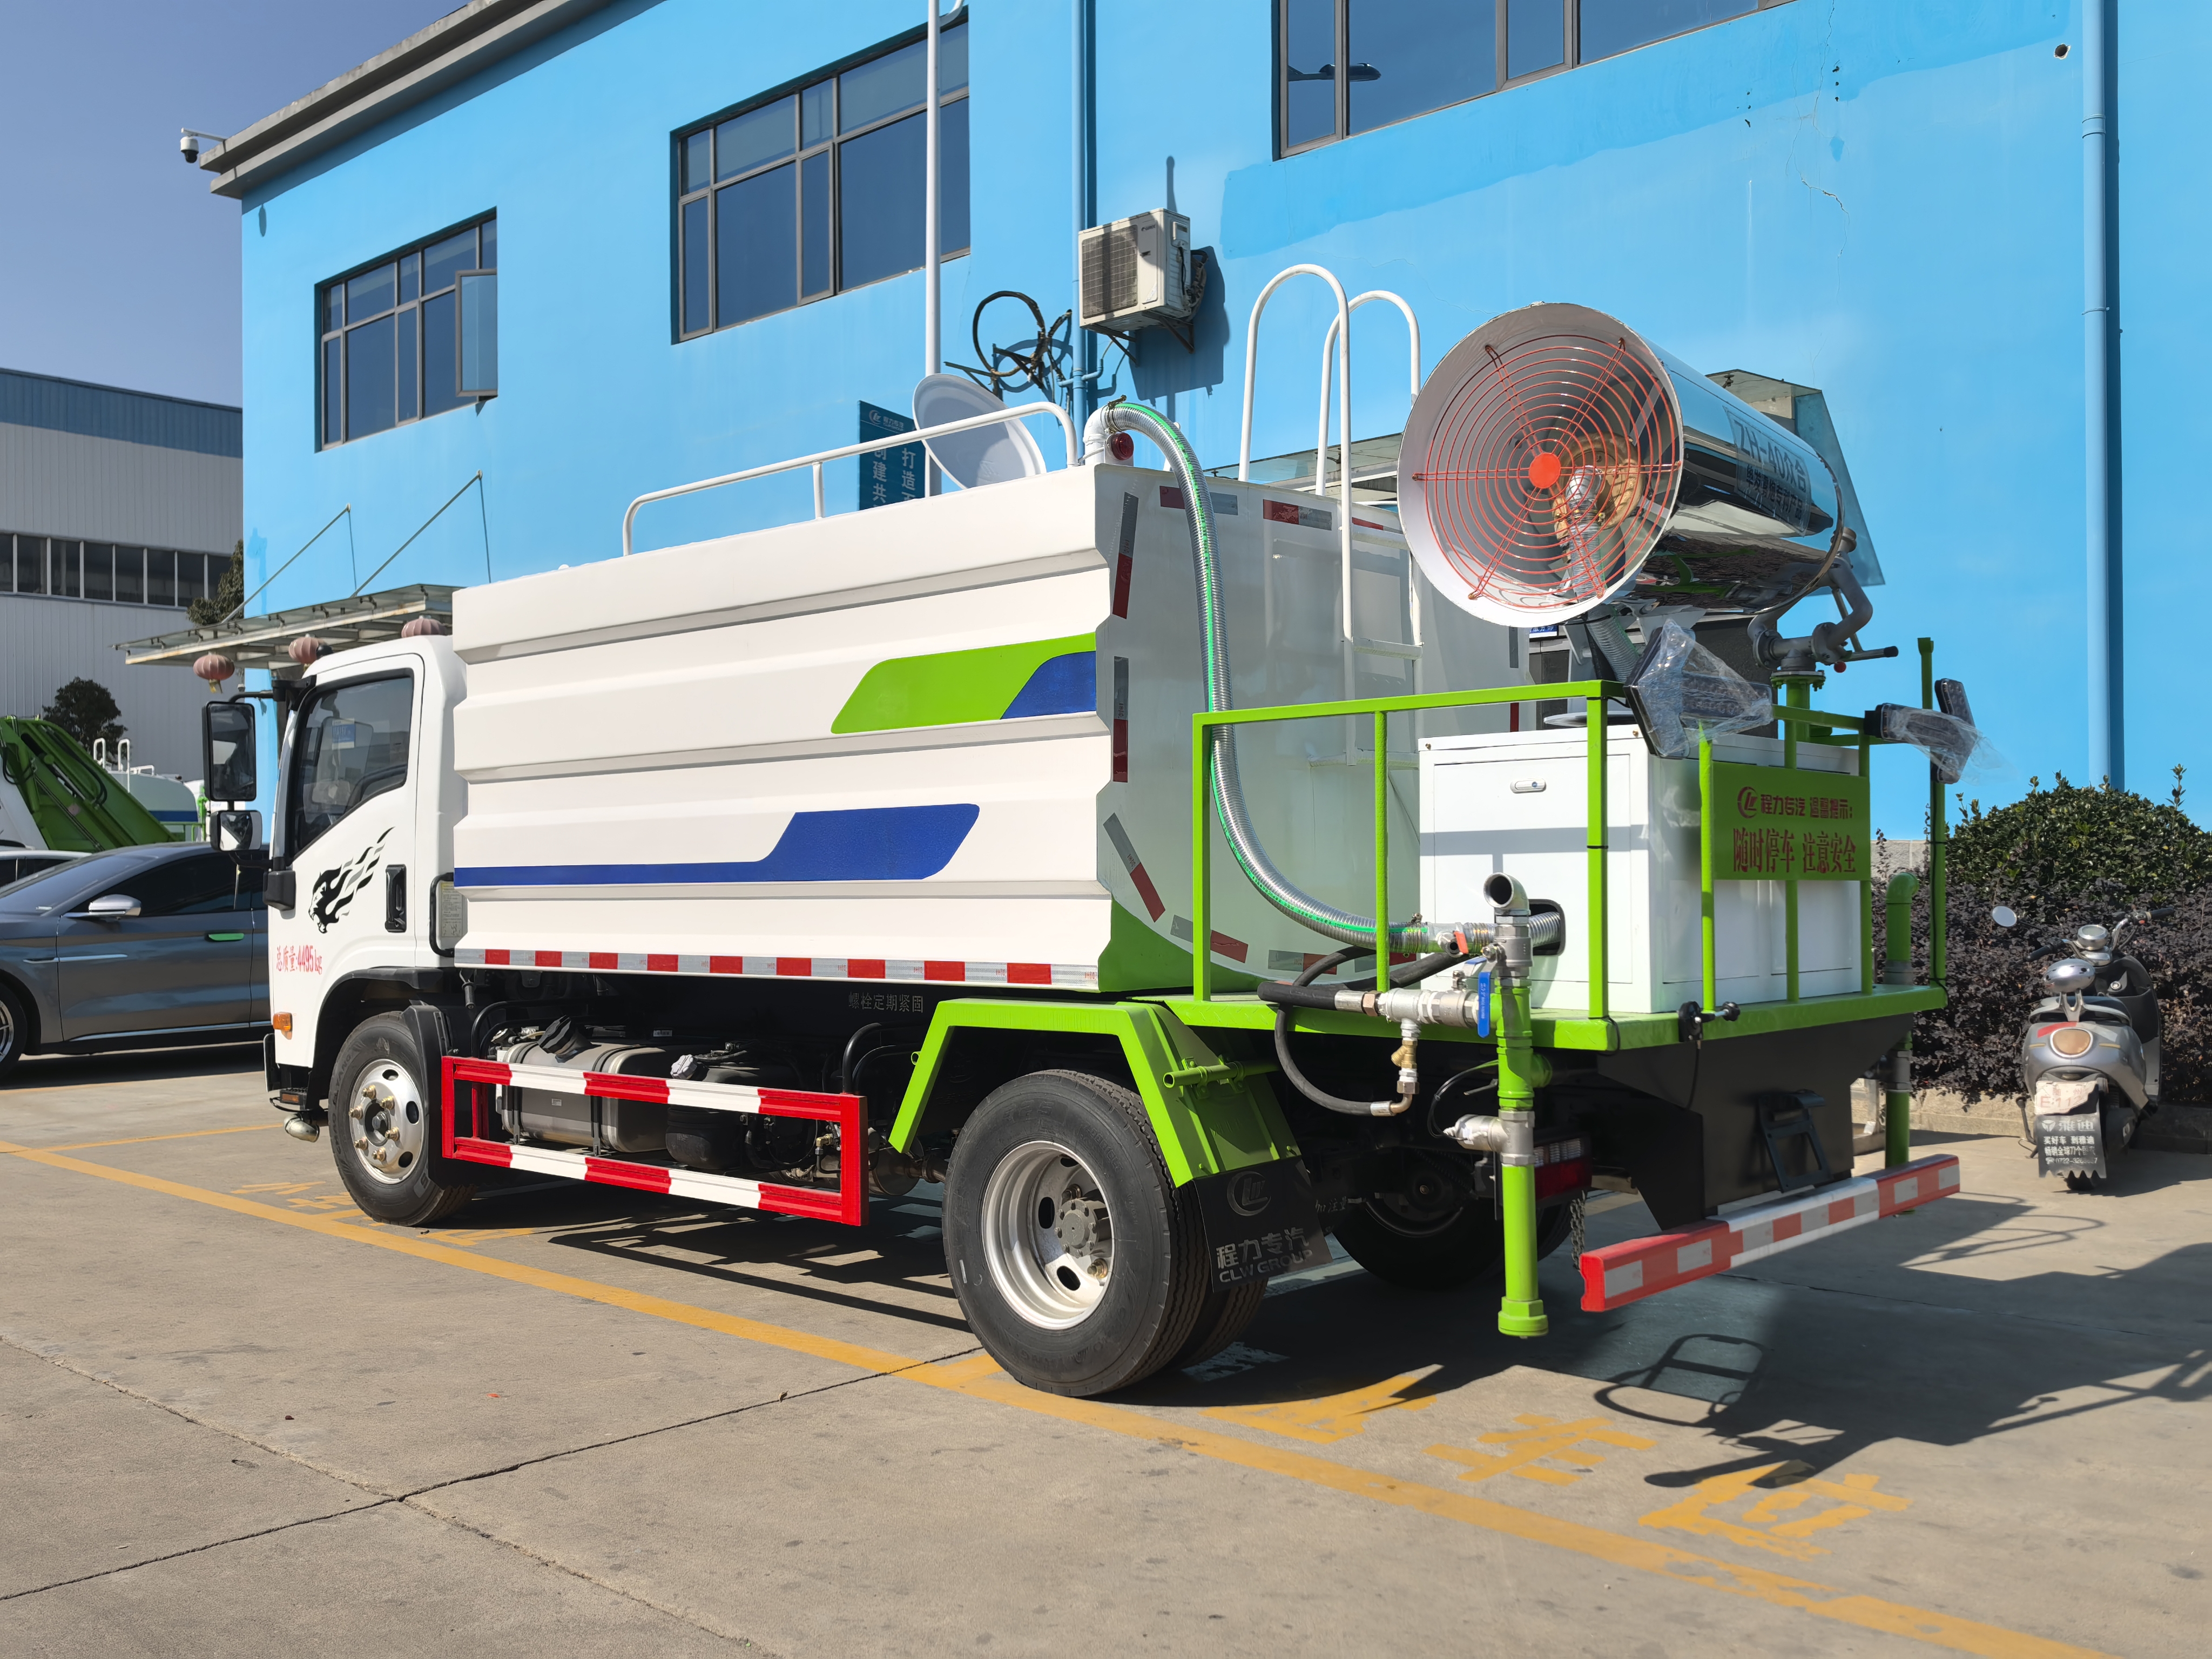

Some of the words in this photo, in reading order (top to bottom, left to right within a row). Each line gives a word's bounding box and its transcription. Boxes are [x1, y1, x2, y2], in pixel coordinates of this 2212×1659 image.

[872, 448, 887, 505] 创建共
[1761, 794, 1805, 817] 程力专汽
[1733, 827, 1795, 873] 随时停车
[1802, 830, 1857, 874] 注意安全
[848, 991, 923, 1013] 螺栓定期紧固
[2043, 1135, 2067, 1145] 买好车
[2059, 1120, 2095, 1132] 雅迪
[1216, 1227, 1310, 1269] 程力专汽
[1219, 1264, 1253, 1283] CLW
[1257, 1249, 1313, 1273] GROUP
